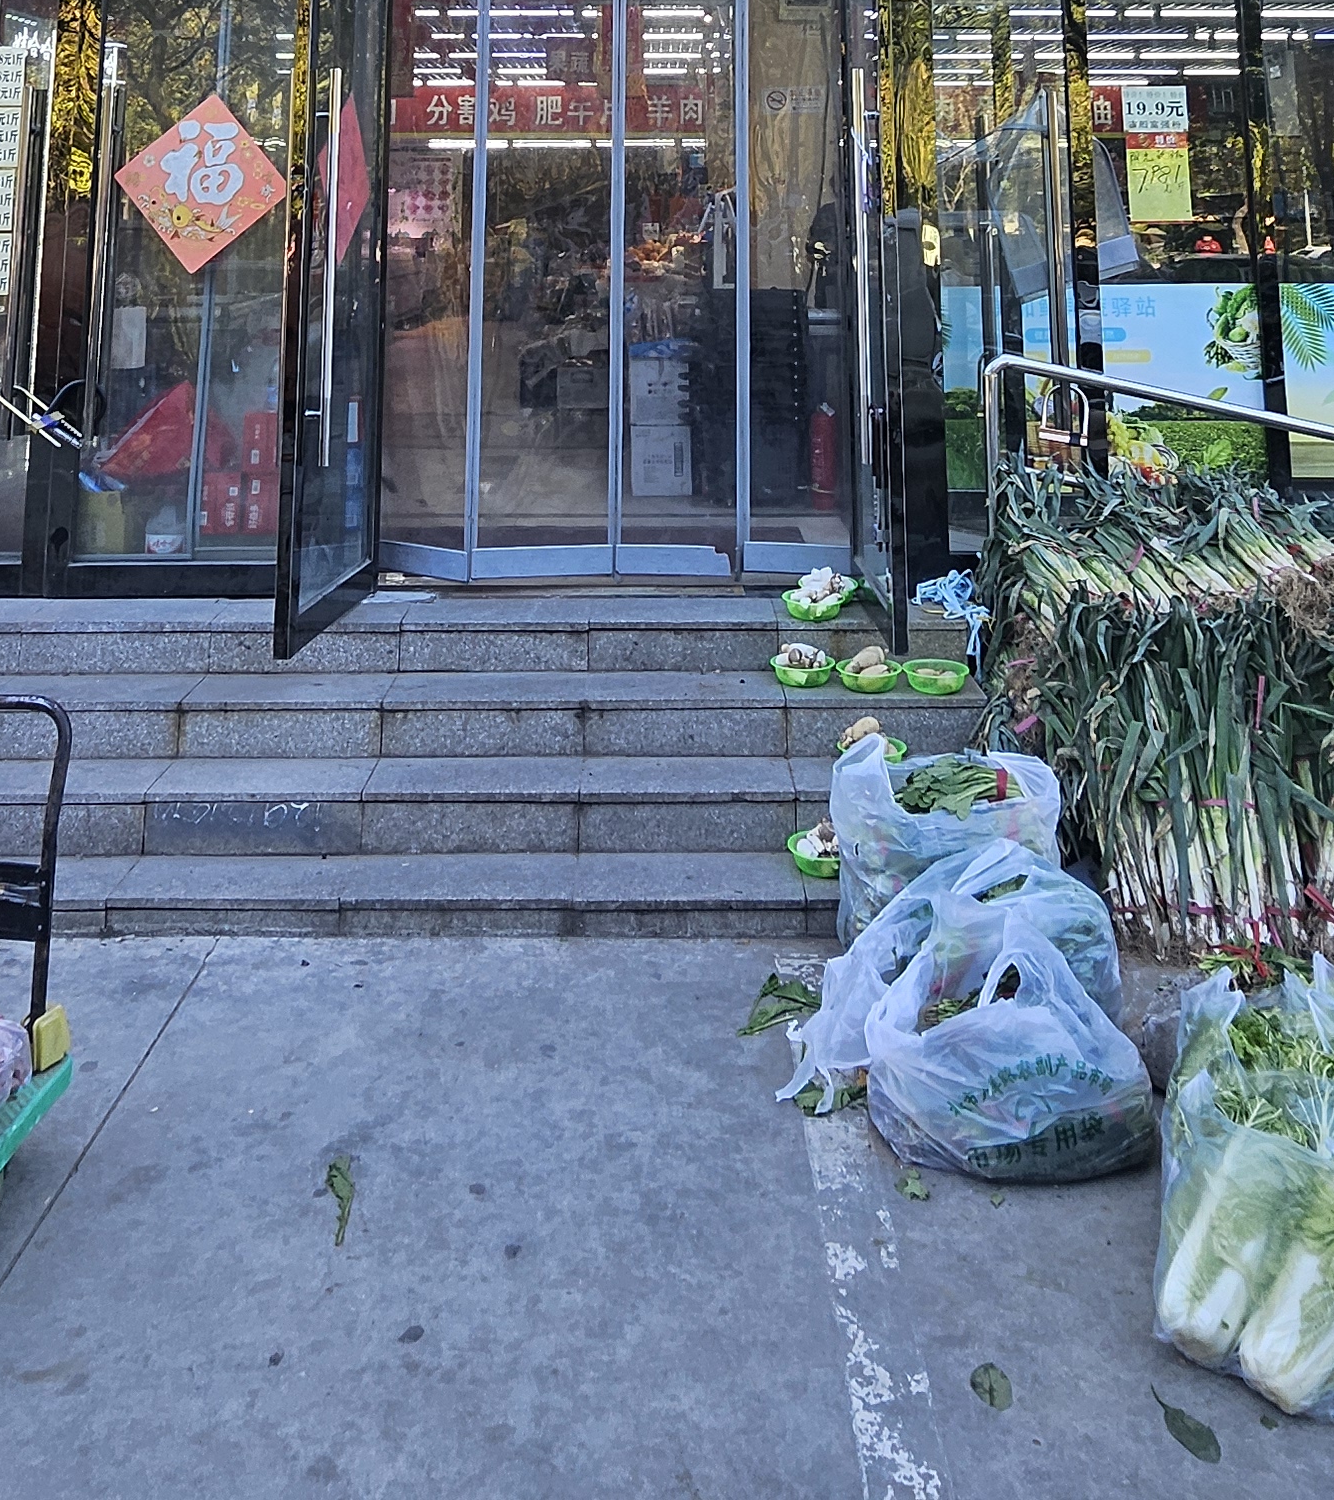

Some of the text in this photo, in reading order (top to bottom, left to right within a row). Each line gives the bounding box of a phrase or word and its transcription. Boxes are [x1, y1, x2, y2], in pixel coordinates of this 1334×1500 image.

[647, 95, 704, 126] 羊肉
[1125, 101, 1185, 117] 19.9元
[160, 119, 244, 206] 福
